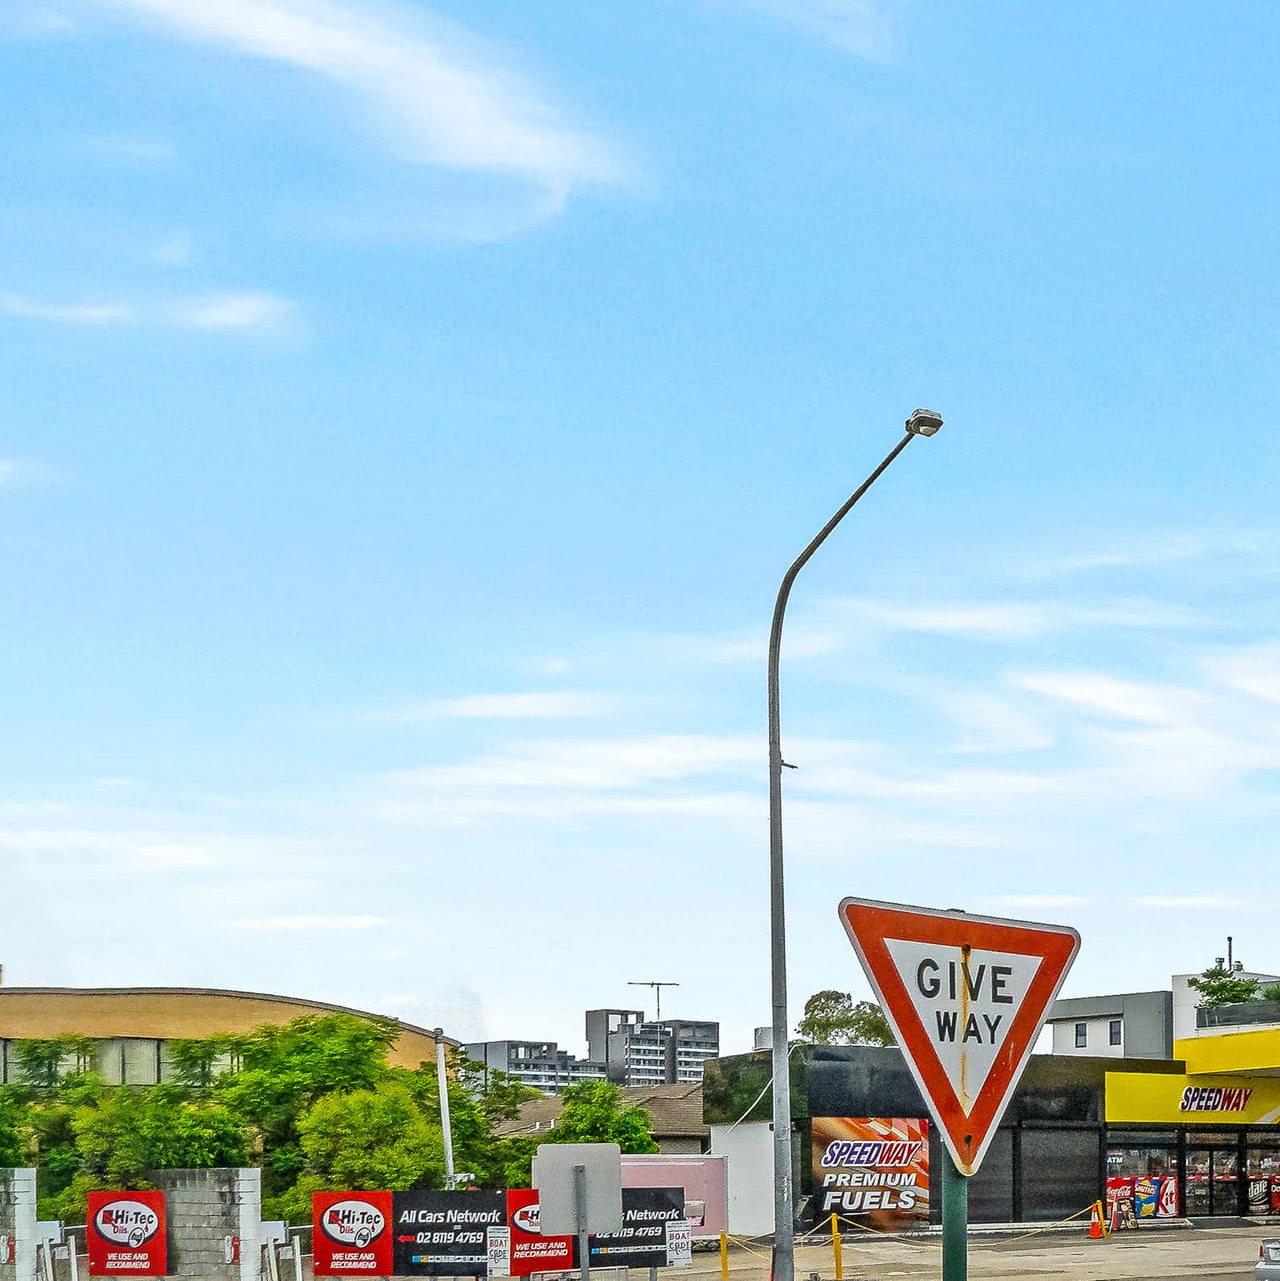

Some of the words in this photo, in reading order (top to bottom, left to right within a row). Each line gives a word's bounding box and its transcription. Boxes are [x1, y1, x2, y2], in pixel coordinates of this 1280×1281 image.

[917, 958, 1013, 1004] GIVE
[936, 1011, 1003, 1044] WAY
[1180, 1086, 1253, 1112] SPEEDWAY
[821, 1140, 921, 1167] SPEEDWAY
[823, 1173, 917, 1187] PREMIUM
[1248, 1180, 1268, 1198] dare
[822, 1190, 916, 1211] FUELS
[114, 1209, 154, 1225] Hi-Tec
[341, 1209, 381, 1225] Hi-Tec
[399, 1210, 416, 1224] All
[418, 1210, 444, 1223] Cars
[447, 1210, 501, 1223] Network
[626, 1209, 680, 1221] Network
[113, 1225, 129, 1234] Oils
[340, 1225, 354, 1235] Oils
[635, 1226, 662, 1237] 4769
[417, 1232, 432, 1244] 02
[432, 1232, 454, 1244] 8119
[456, 1231, 484, 1243] 4769
[489, 1239, 508, 1248] BOAT
[515, 1243, 530, 1251] WE
[530, 1242, 548, 1250] USE
[548, 1241, 567, 1249] AND
[118, 1252, 132, 1260] USE
[132, 1252, 149, 1260] AND
[332, 1252, 346, 1261] WE
[346, 1252, 359, 1261] USE
[359, 1252, 375, 1261] AND
[513, 1249, 569, 1259] RECOMMEND
[105, 1261, 150, 1269] RECOMMEND
[330, 1261, 376, 1269] RECOMMEND
